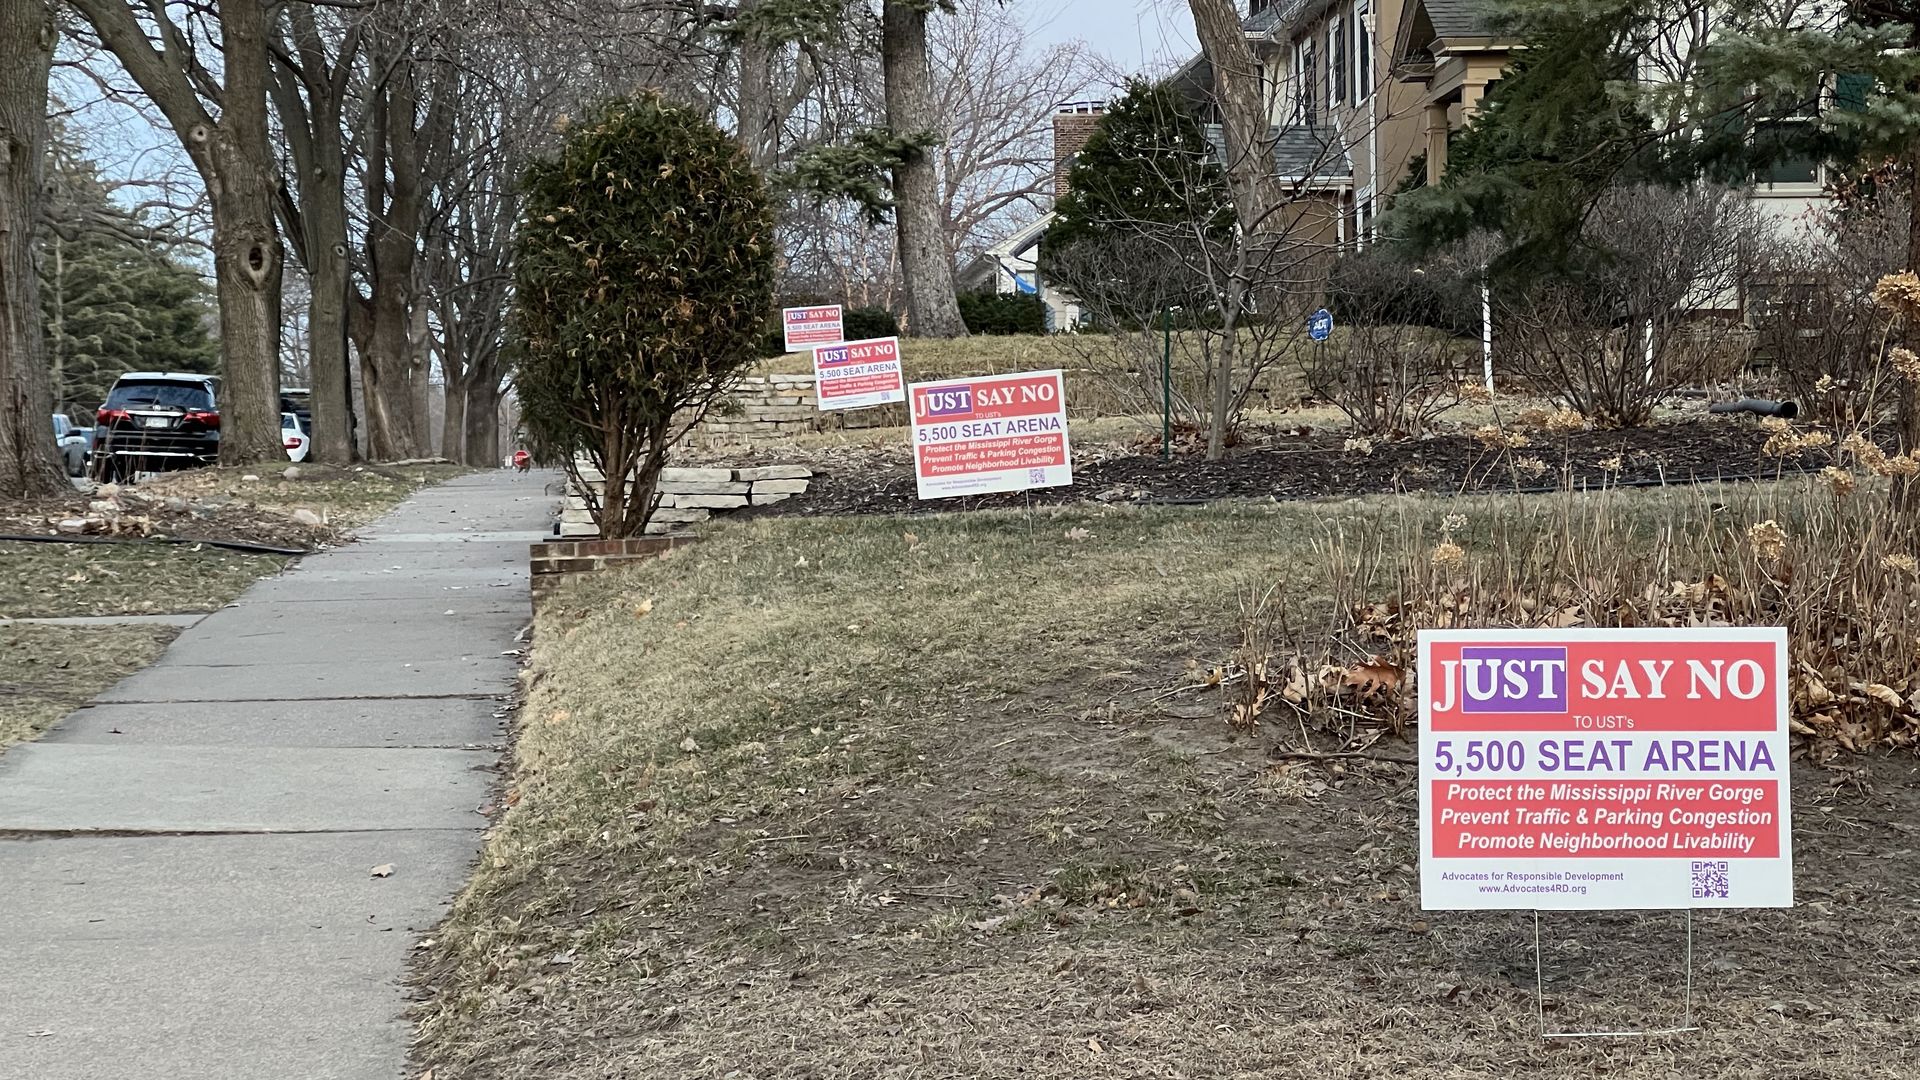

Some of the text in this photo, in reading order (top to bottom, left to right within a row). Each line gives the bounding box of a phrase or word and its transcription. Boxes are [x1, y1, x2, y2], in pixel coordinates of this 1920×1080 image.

[787, 310, 838, 322] JUST SAY NO
[817, 349, 848, 365] JUST
[851, 346, 872, 358] SAY
[874, 344, 893, 356] NO
[843, 366, 865, 376] SEAT
[867, 362, 898, 373] ARENA
[916, 383, 1054, 417] JUST SAY NO
[919, 417, 1061, 443] 5,500 SEAT ARENA
[923, 445, 1061, 464] Prevent Traffic & Parking Congestion
[925, 444, 953, 453] Protect
[954, 443, 967, 451] the
[968, 438, 1011, 450] Mississippi
[1034, 436, 1058, 445] Gorge
[931, 455, 1055, 473] Promote Neighborhood Livability
[1432, 659, 1766, 712] JUST SAY NO
[1573, 715, 1635, 729] TO UST's
[1434, 740, 1776, 777] 5,500 SEAT ARENA
[1447, 783, 1764, 804] Protect the Mississippi River Gorge
[1440, 808, 1772, 829] Prevent Traffic & Parking Congestion
[1458, 832, 1755, 853] Promote Neighborhood Livability
[1441, 872, 1624, 883] Advocates for Responsible Development
[1478, 884, 1587, 895] www.Advocates4RD.org
